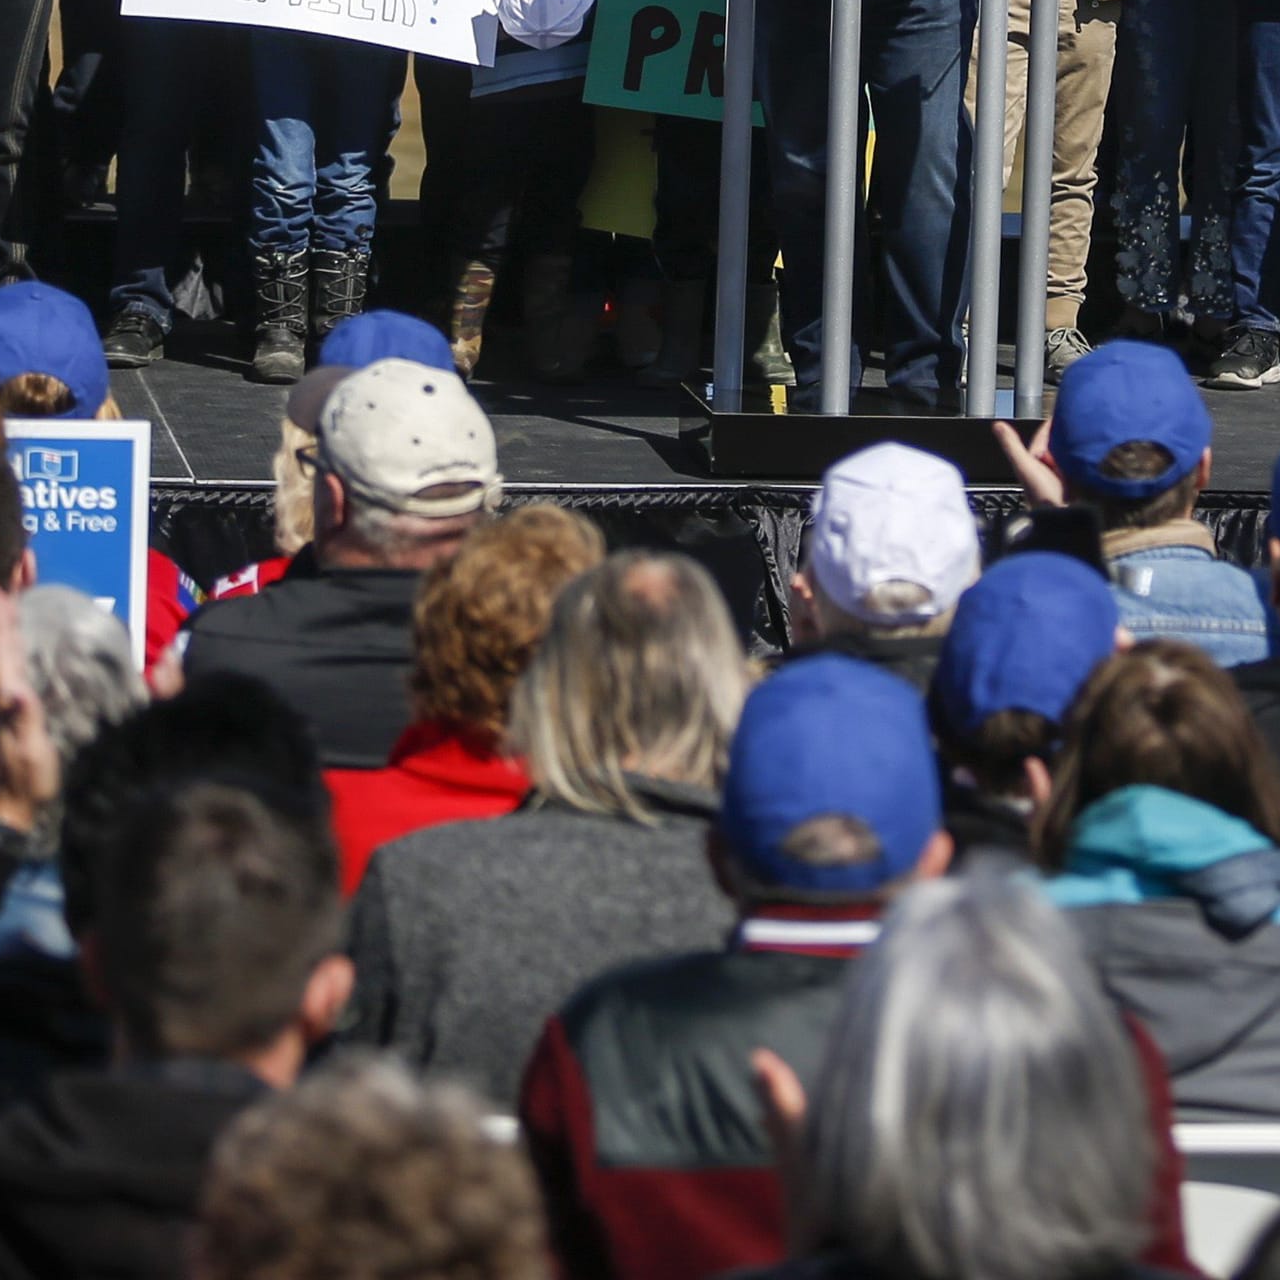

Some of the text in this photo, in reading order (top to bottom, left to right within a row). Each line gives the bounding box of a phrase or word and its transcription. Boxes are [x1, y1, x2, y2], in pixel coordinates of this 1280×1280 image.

[20, 480, 118, 510] atives
[43, 510, 61, 532] &
[66, 510, 118, 533] Free
